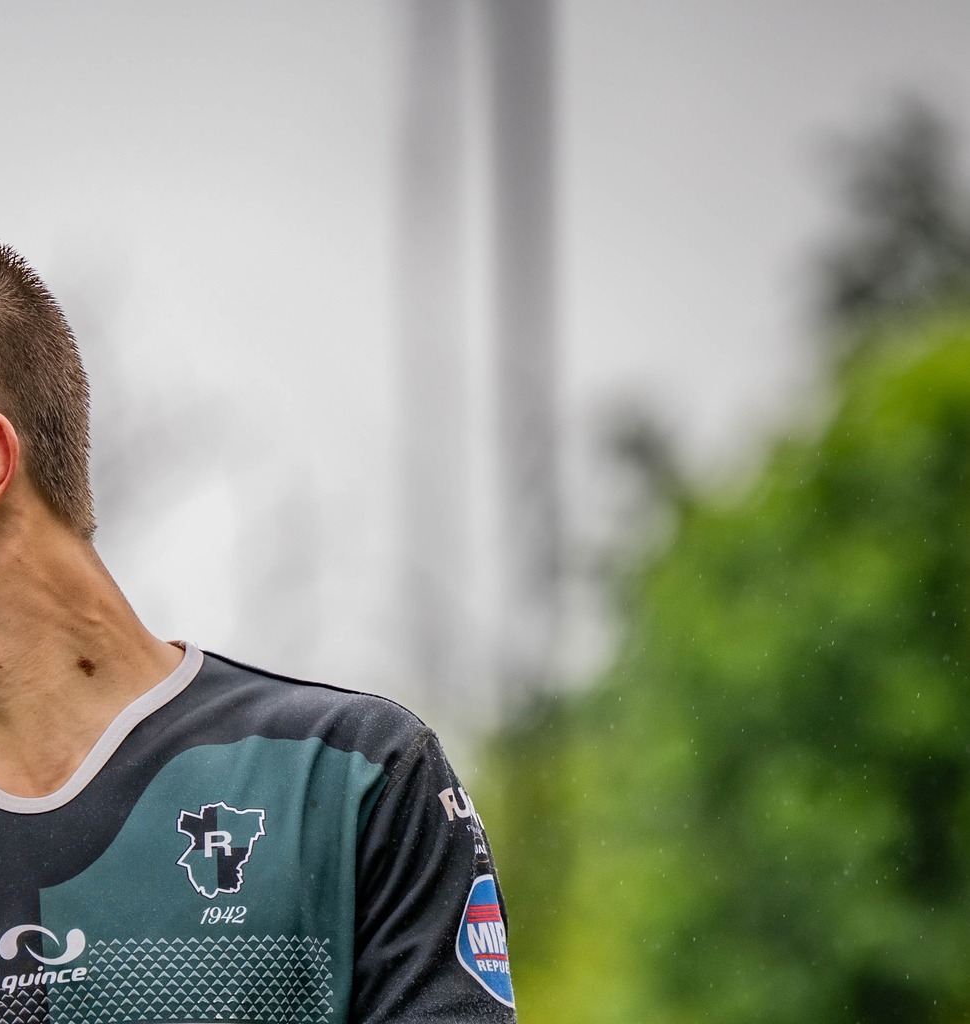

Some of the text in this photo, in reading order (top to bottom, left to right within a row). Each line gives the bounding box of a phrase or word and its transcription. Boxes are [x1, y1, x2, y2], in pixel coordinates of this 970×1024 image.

[204, 830, 232, 857] R
[200, 905, 247, 924] 1942
[1, 966, 87, 995] quince
